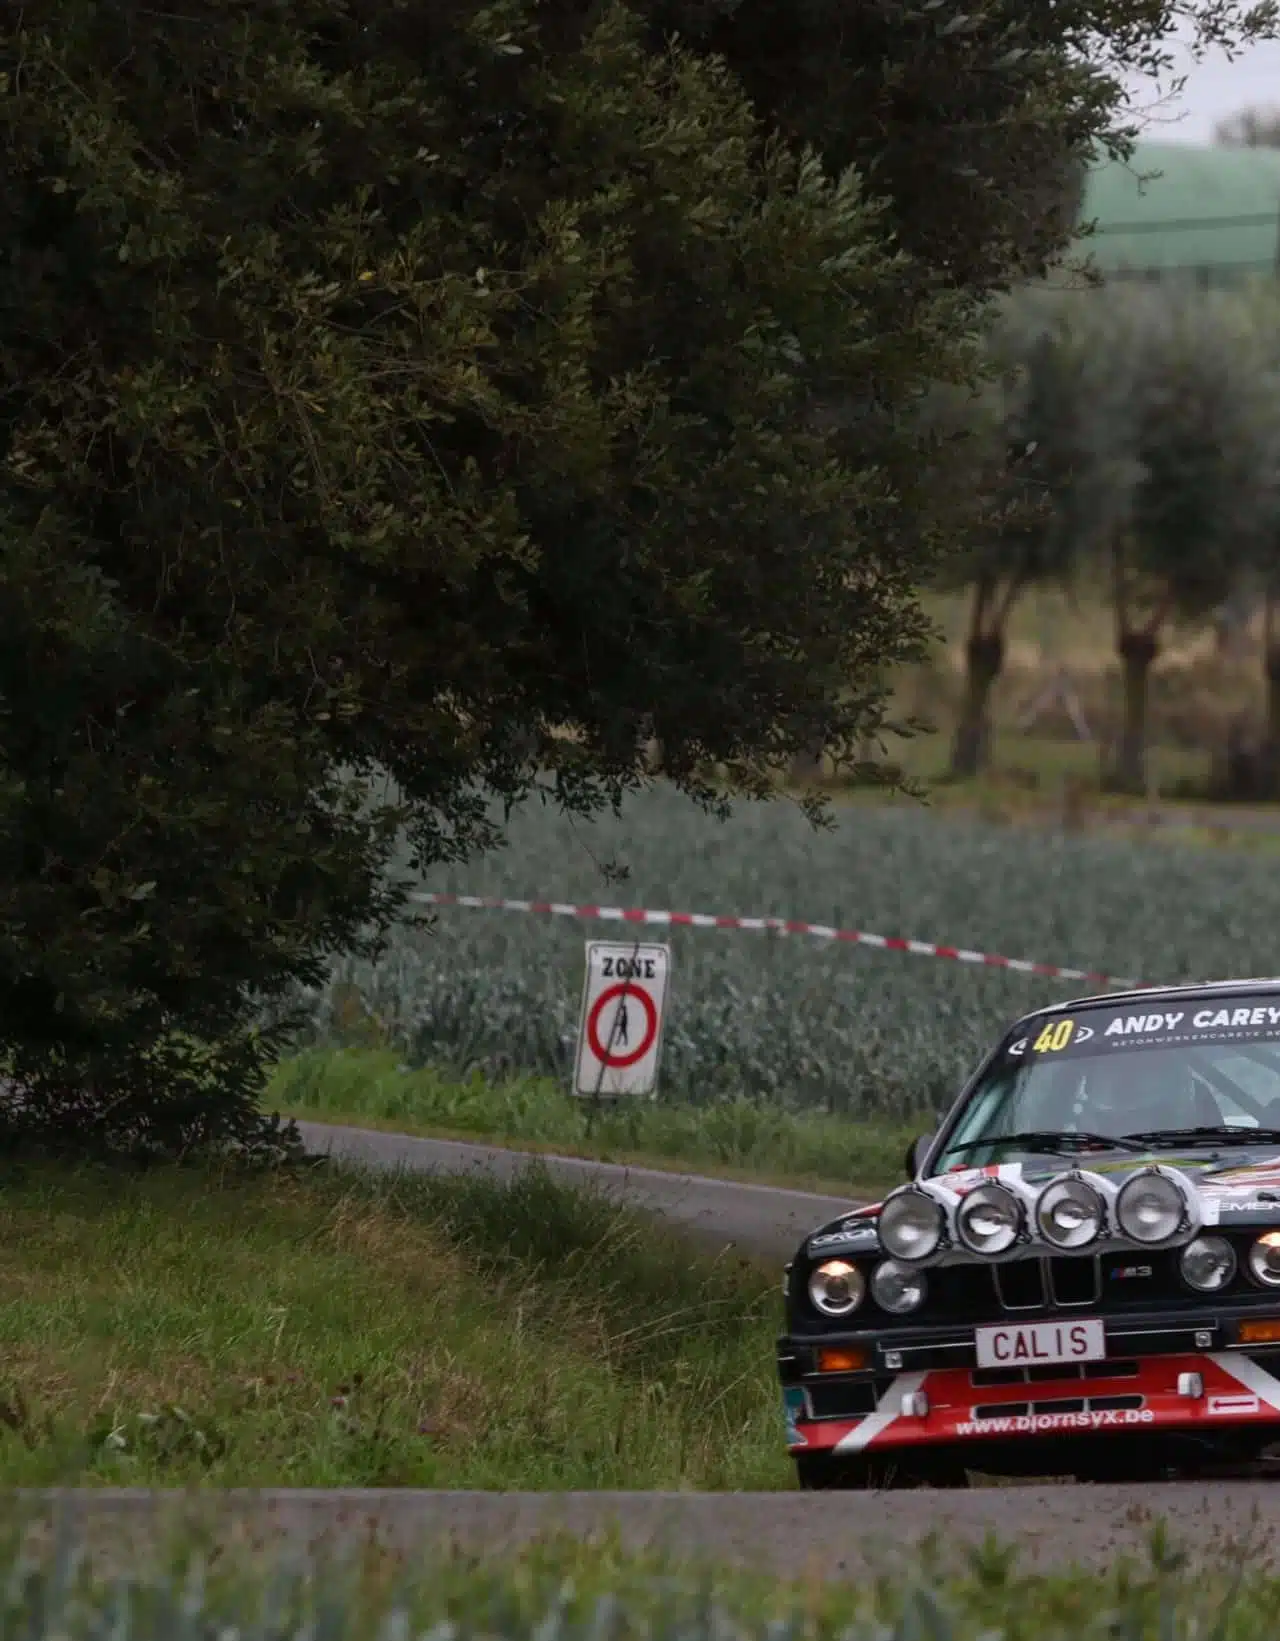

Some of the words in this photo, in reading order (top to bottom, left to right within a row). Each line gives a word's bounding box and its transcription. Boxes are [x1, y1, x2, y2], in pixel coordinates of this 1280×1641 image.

[601, 957, 656, 979] ZONE
[1032, 1019, 1075, 1053] 40
[1104, 1012, 1185, 1037] ANDY
[955, 1407, 1154, 1436] www.bjornsyx.be
